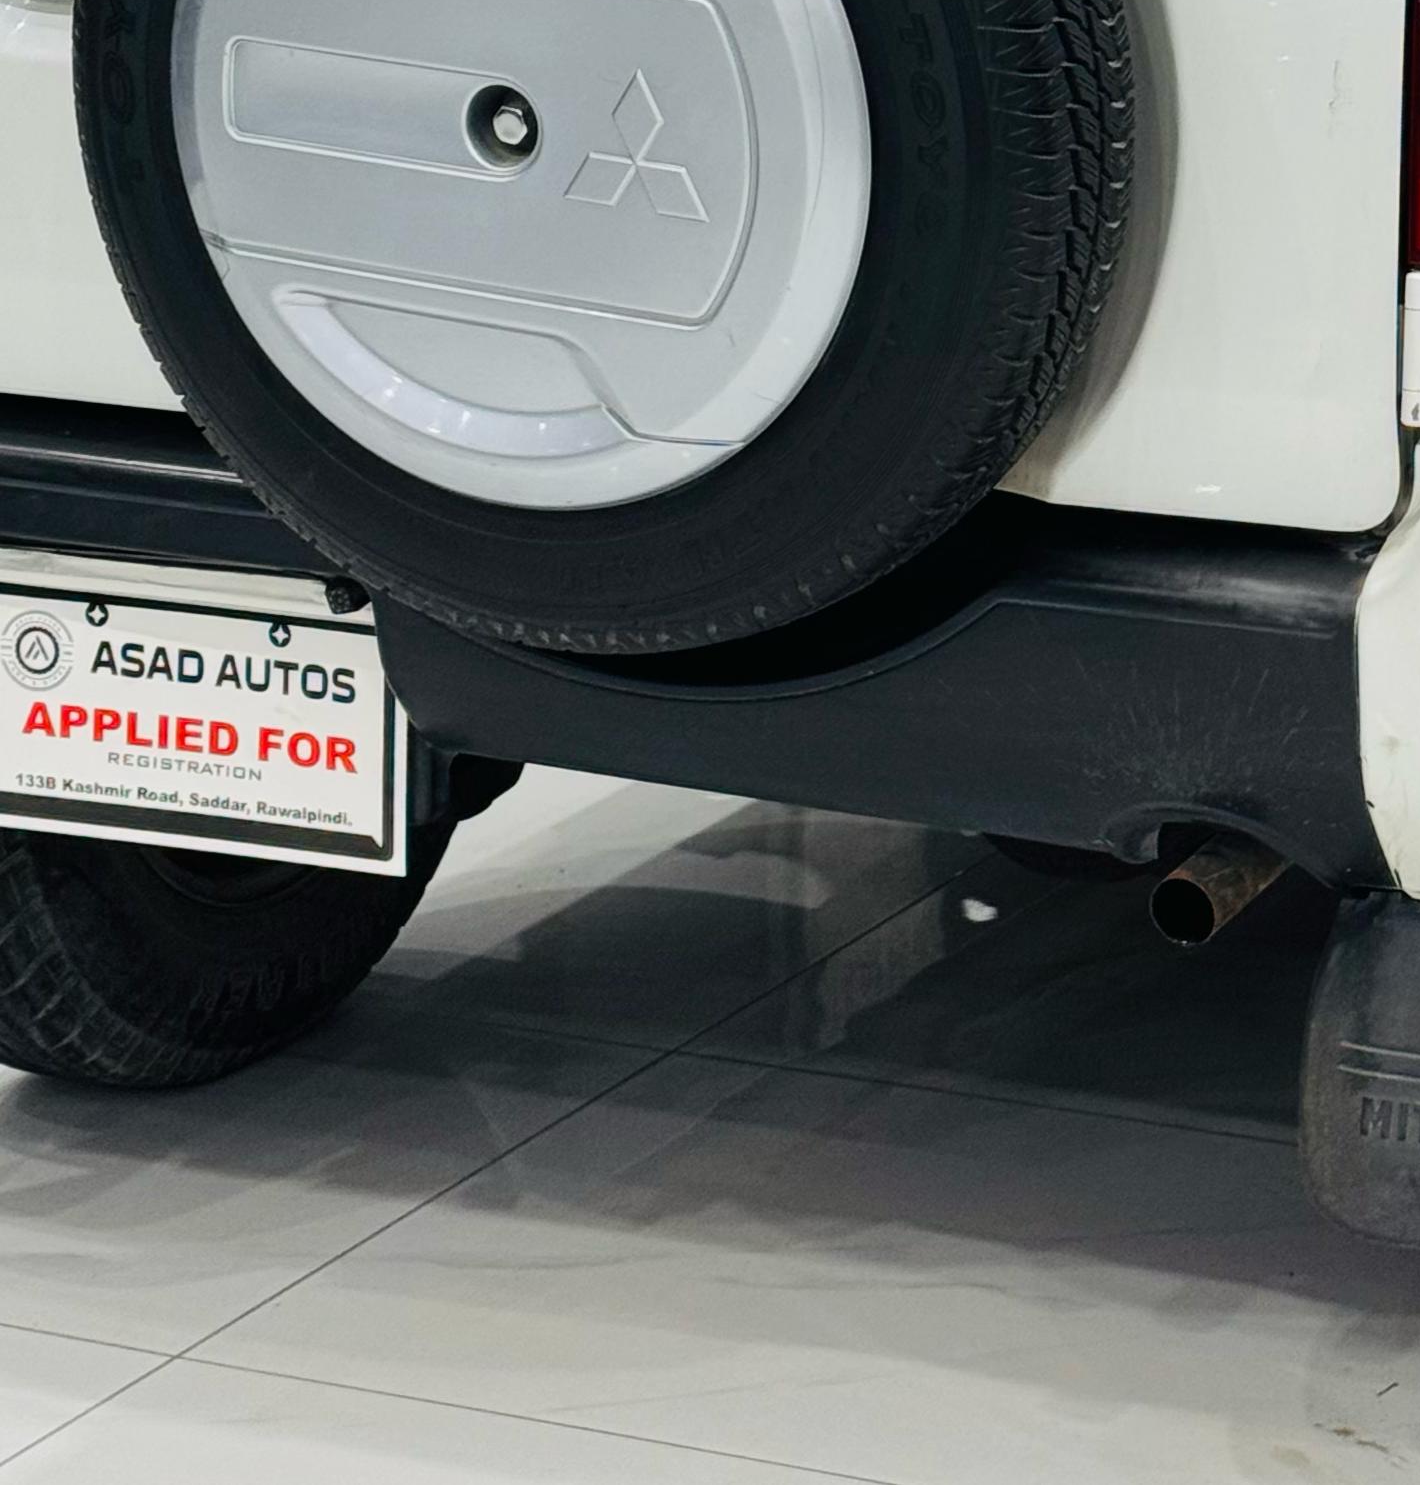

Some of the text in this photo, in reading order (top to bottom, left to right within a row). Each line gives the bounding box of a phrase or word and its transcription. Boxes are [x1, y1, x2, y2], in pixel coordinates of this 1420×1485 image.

[90, 640, 205, 684] ASAD
[214, 653, 357, 704] AUTOS
[22, 701, 358, 775] APPLIED FOR
[107, 751, 263, 782] REGISTRATION
[15, 772, 353, 827] 133B Kashmir Road, Saddar, Rawalpindi.
